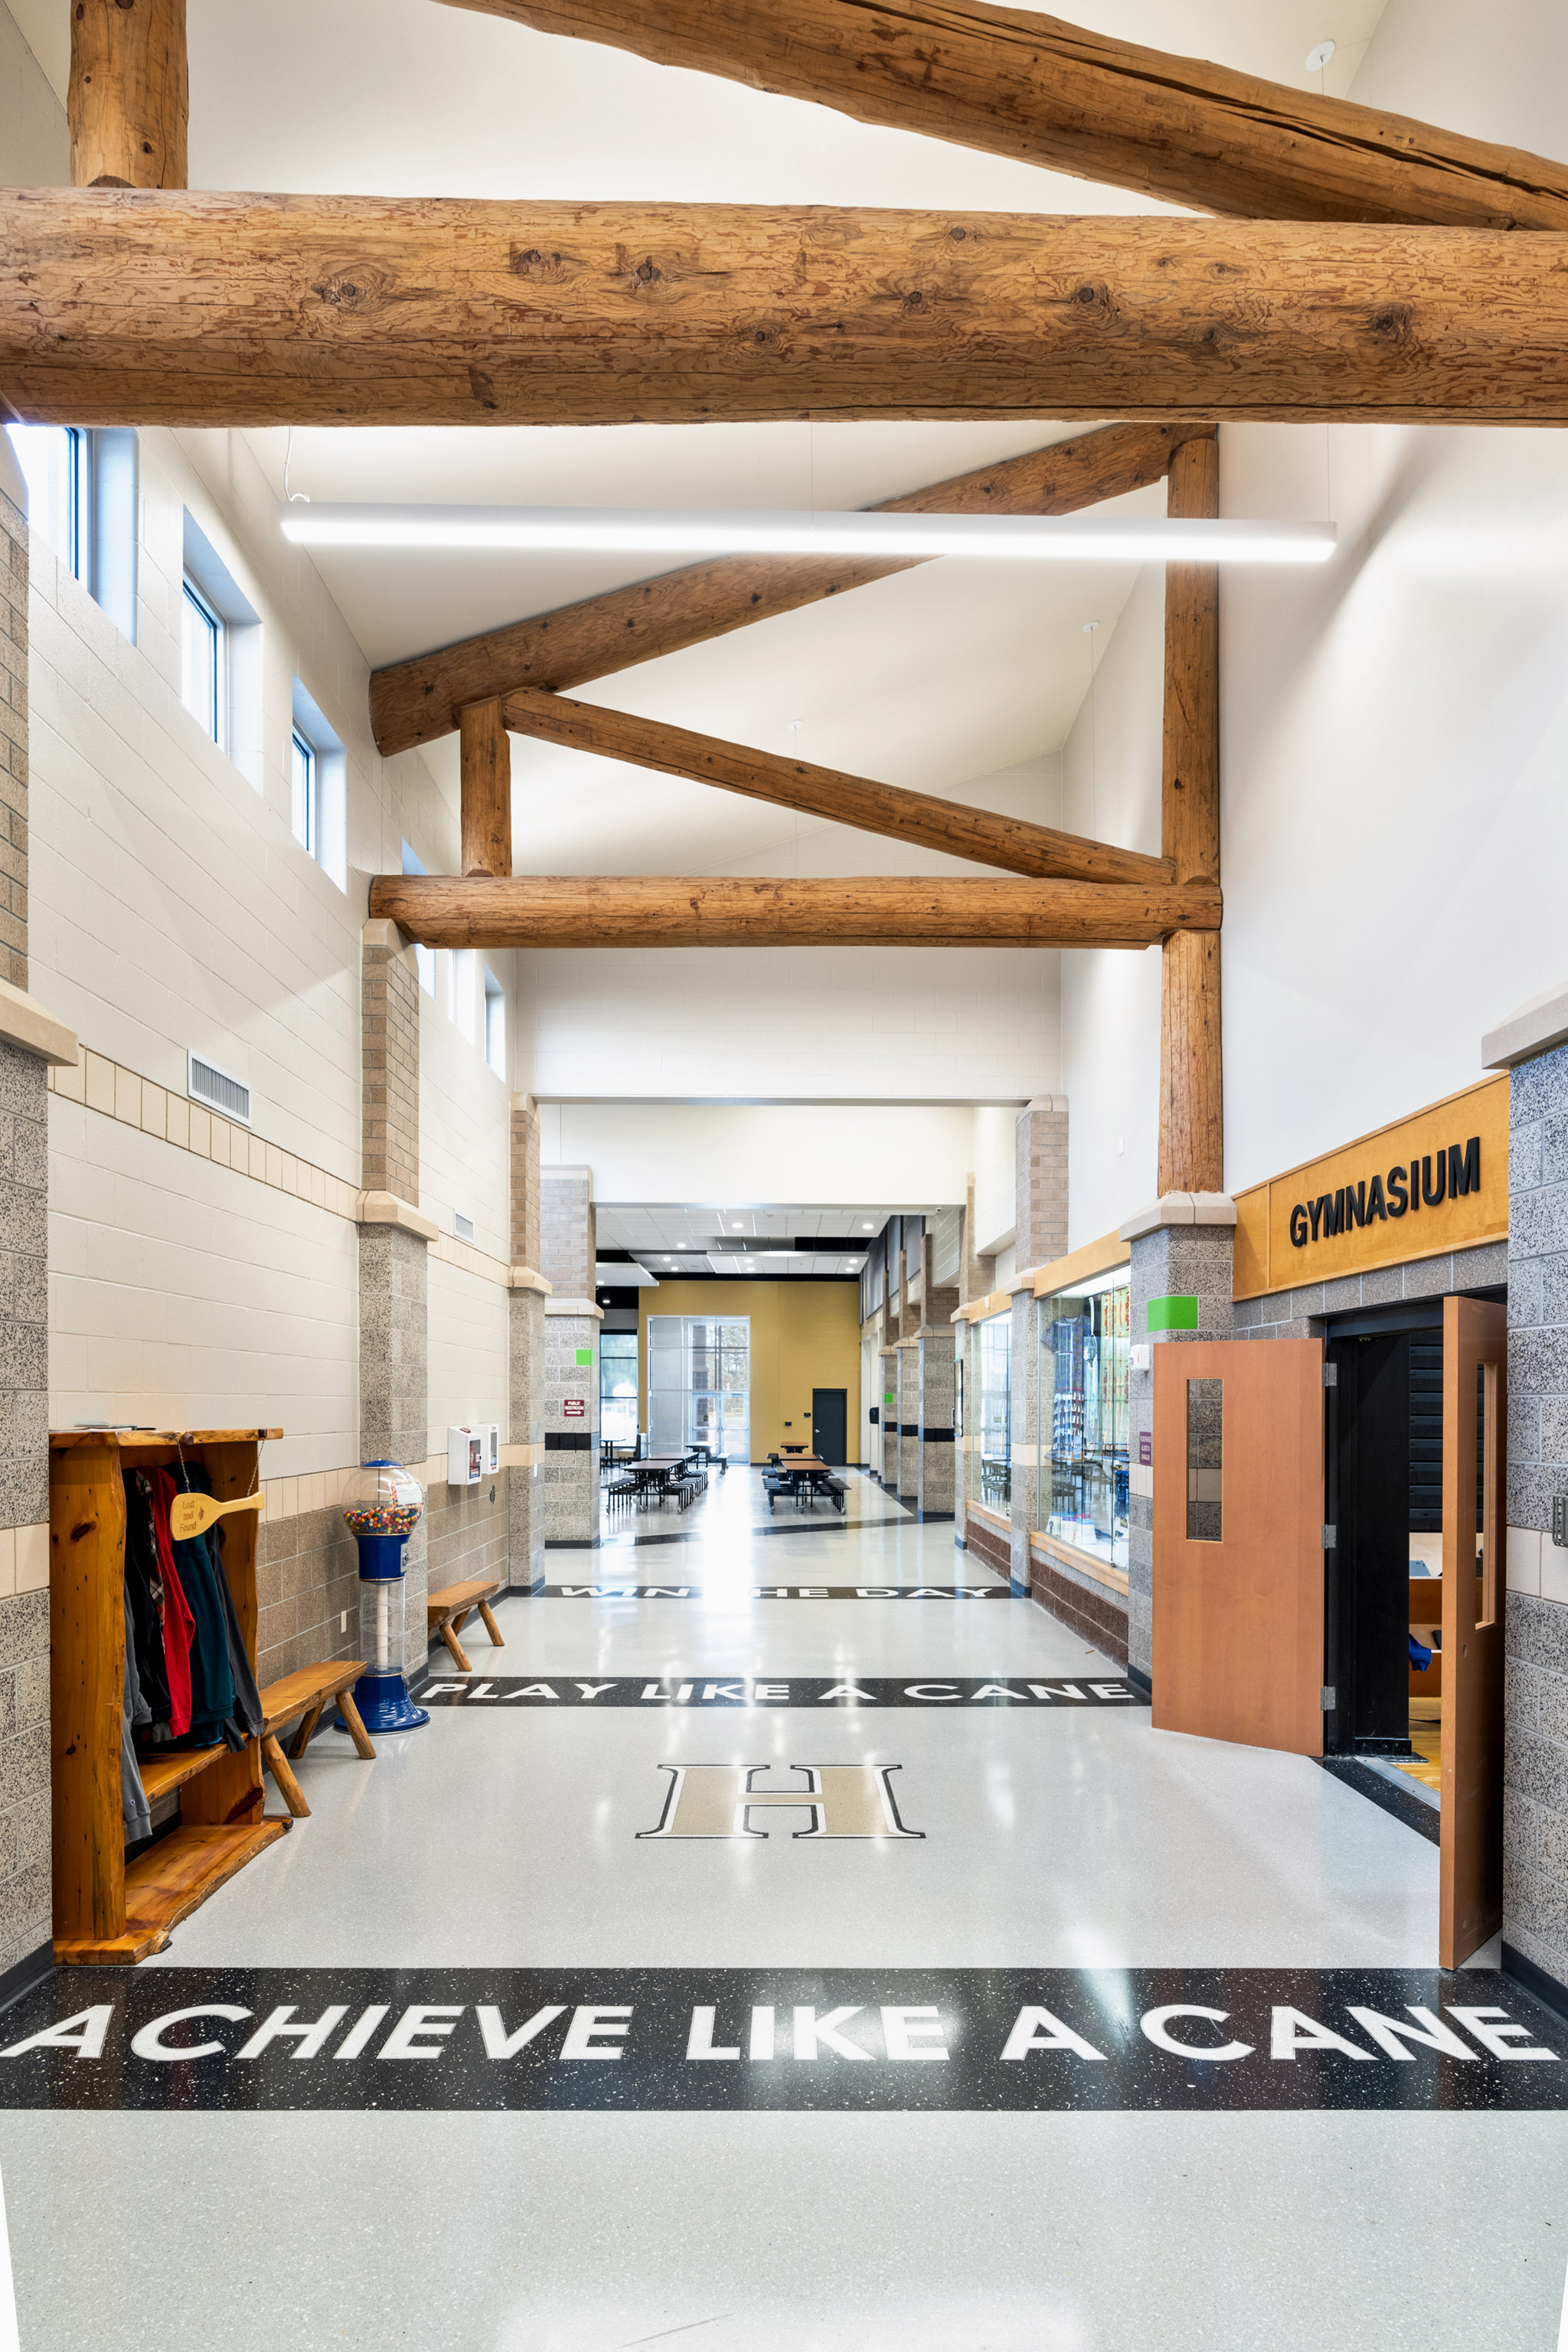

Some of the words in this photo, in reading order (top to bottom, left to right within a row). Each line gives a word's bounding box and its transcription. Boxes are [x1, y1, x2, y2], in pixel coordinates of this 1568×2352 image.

[1289, 1135, 1481, 1248] GYMNASIUM
[182, 1500, 195, 1510] Lost
[183, 1511, 194, 1521] and
[179, 1521, 197, 1533] Found
[560, 1586, 691, 1598] WIN
[749, 1587, 829, 1598] HE
[855, 1587, 994, 1598] DAY
[420, 1684, 619, 1700] PLAY
[640, 1684, 789, 1700] LIKE
[817, 1684, 878, 1700] A
[903, 1684, 1135, 1700] CANE
[635, 1763, 927, 1839] H
[0, 2004, 634, 2061] ACHIEVE
[685, 2005, 950, 2060] LIKE
[998, 2005, 1110, 2060] A
[1139, 2004, 1563, 2061] CANE
